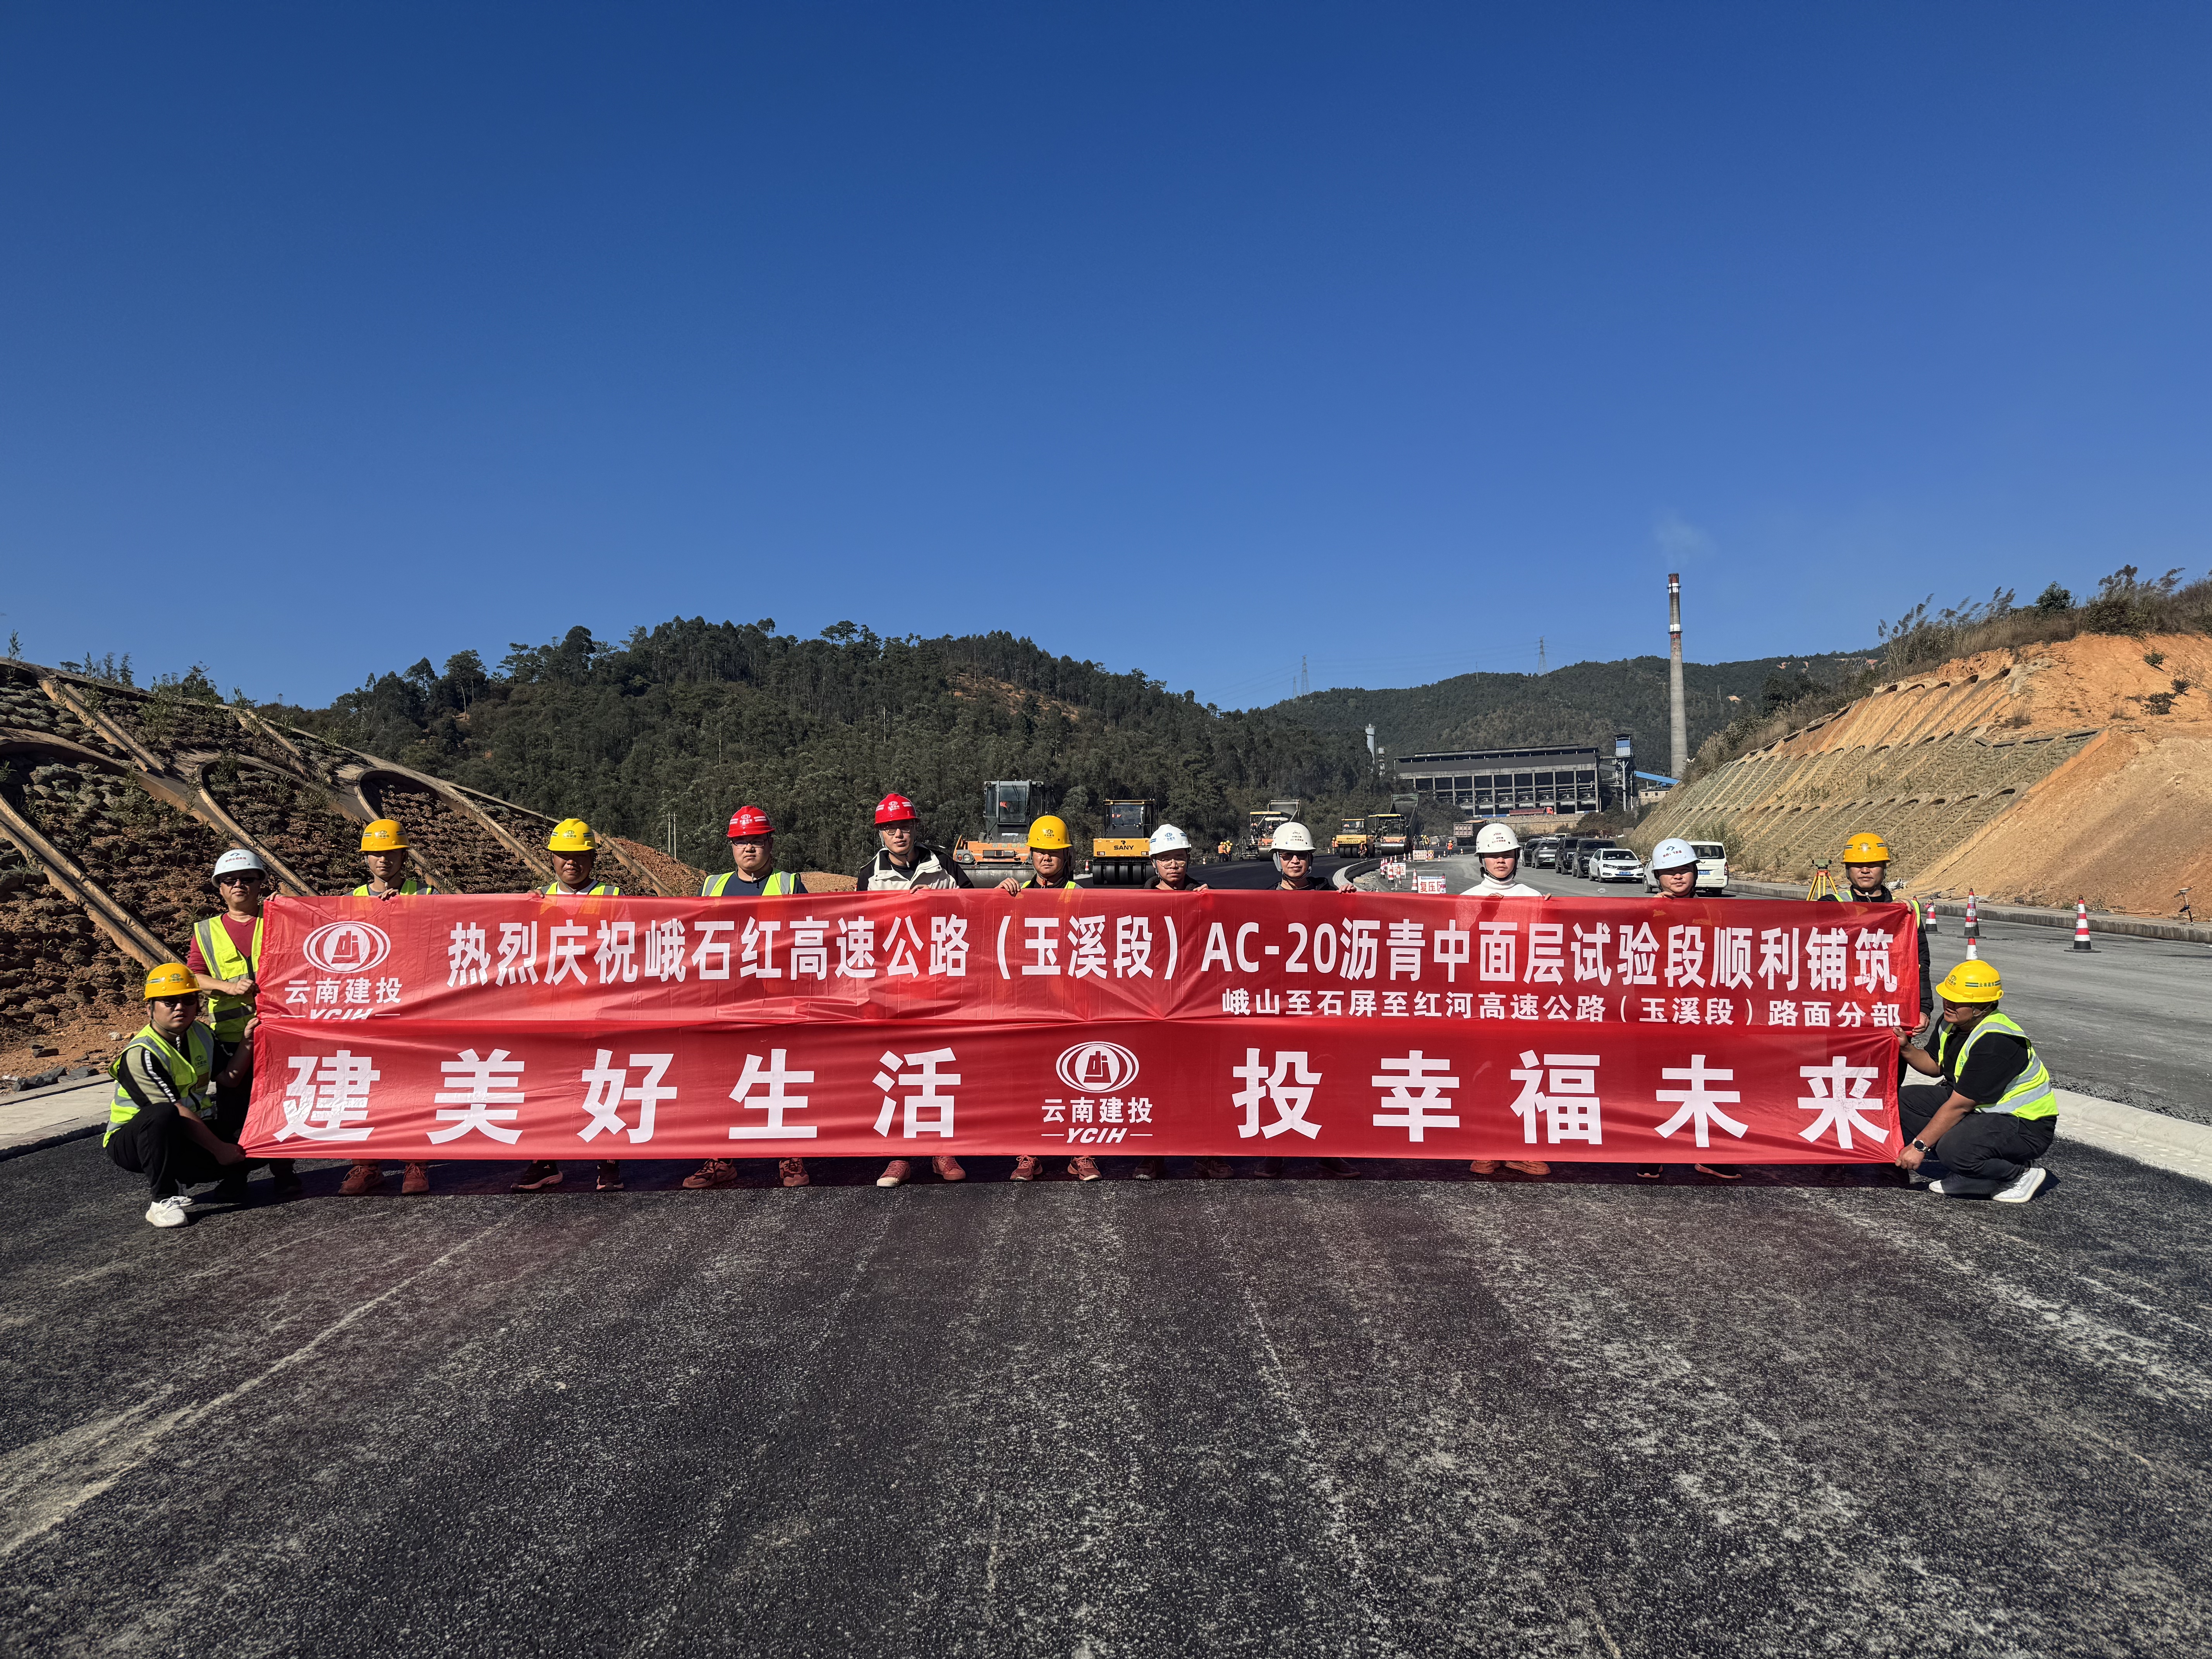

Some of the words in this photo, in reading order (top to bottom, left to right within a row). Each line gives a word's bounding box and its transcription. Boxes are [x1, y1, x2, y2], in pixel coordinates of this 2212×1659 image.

[284, 977, 403, 1005] 云南建投
[1041, 1096, 1153, 1124] 云南建投
[1066, 1127, 1128, 1144] YCIH
